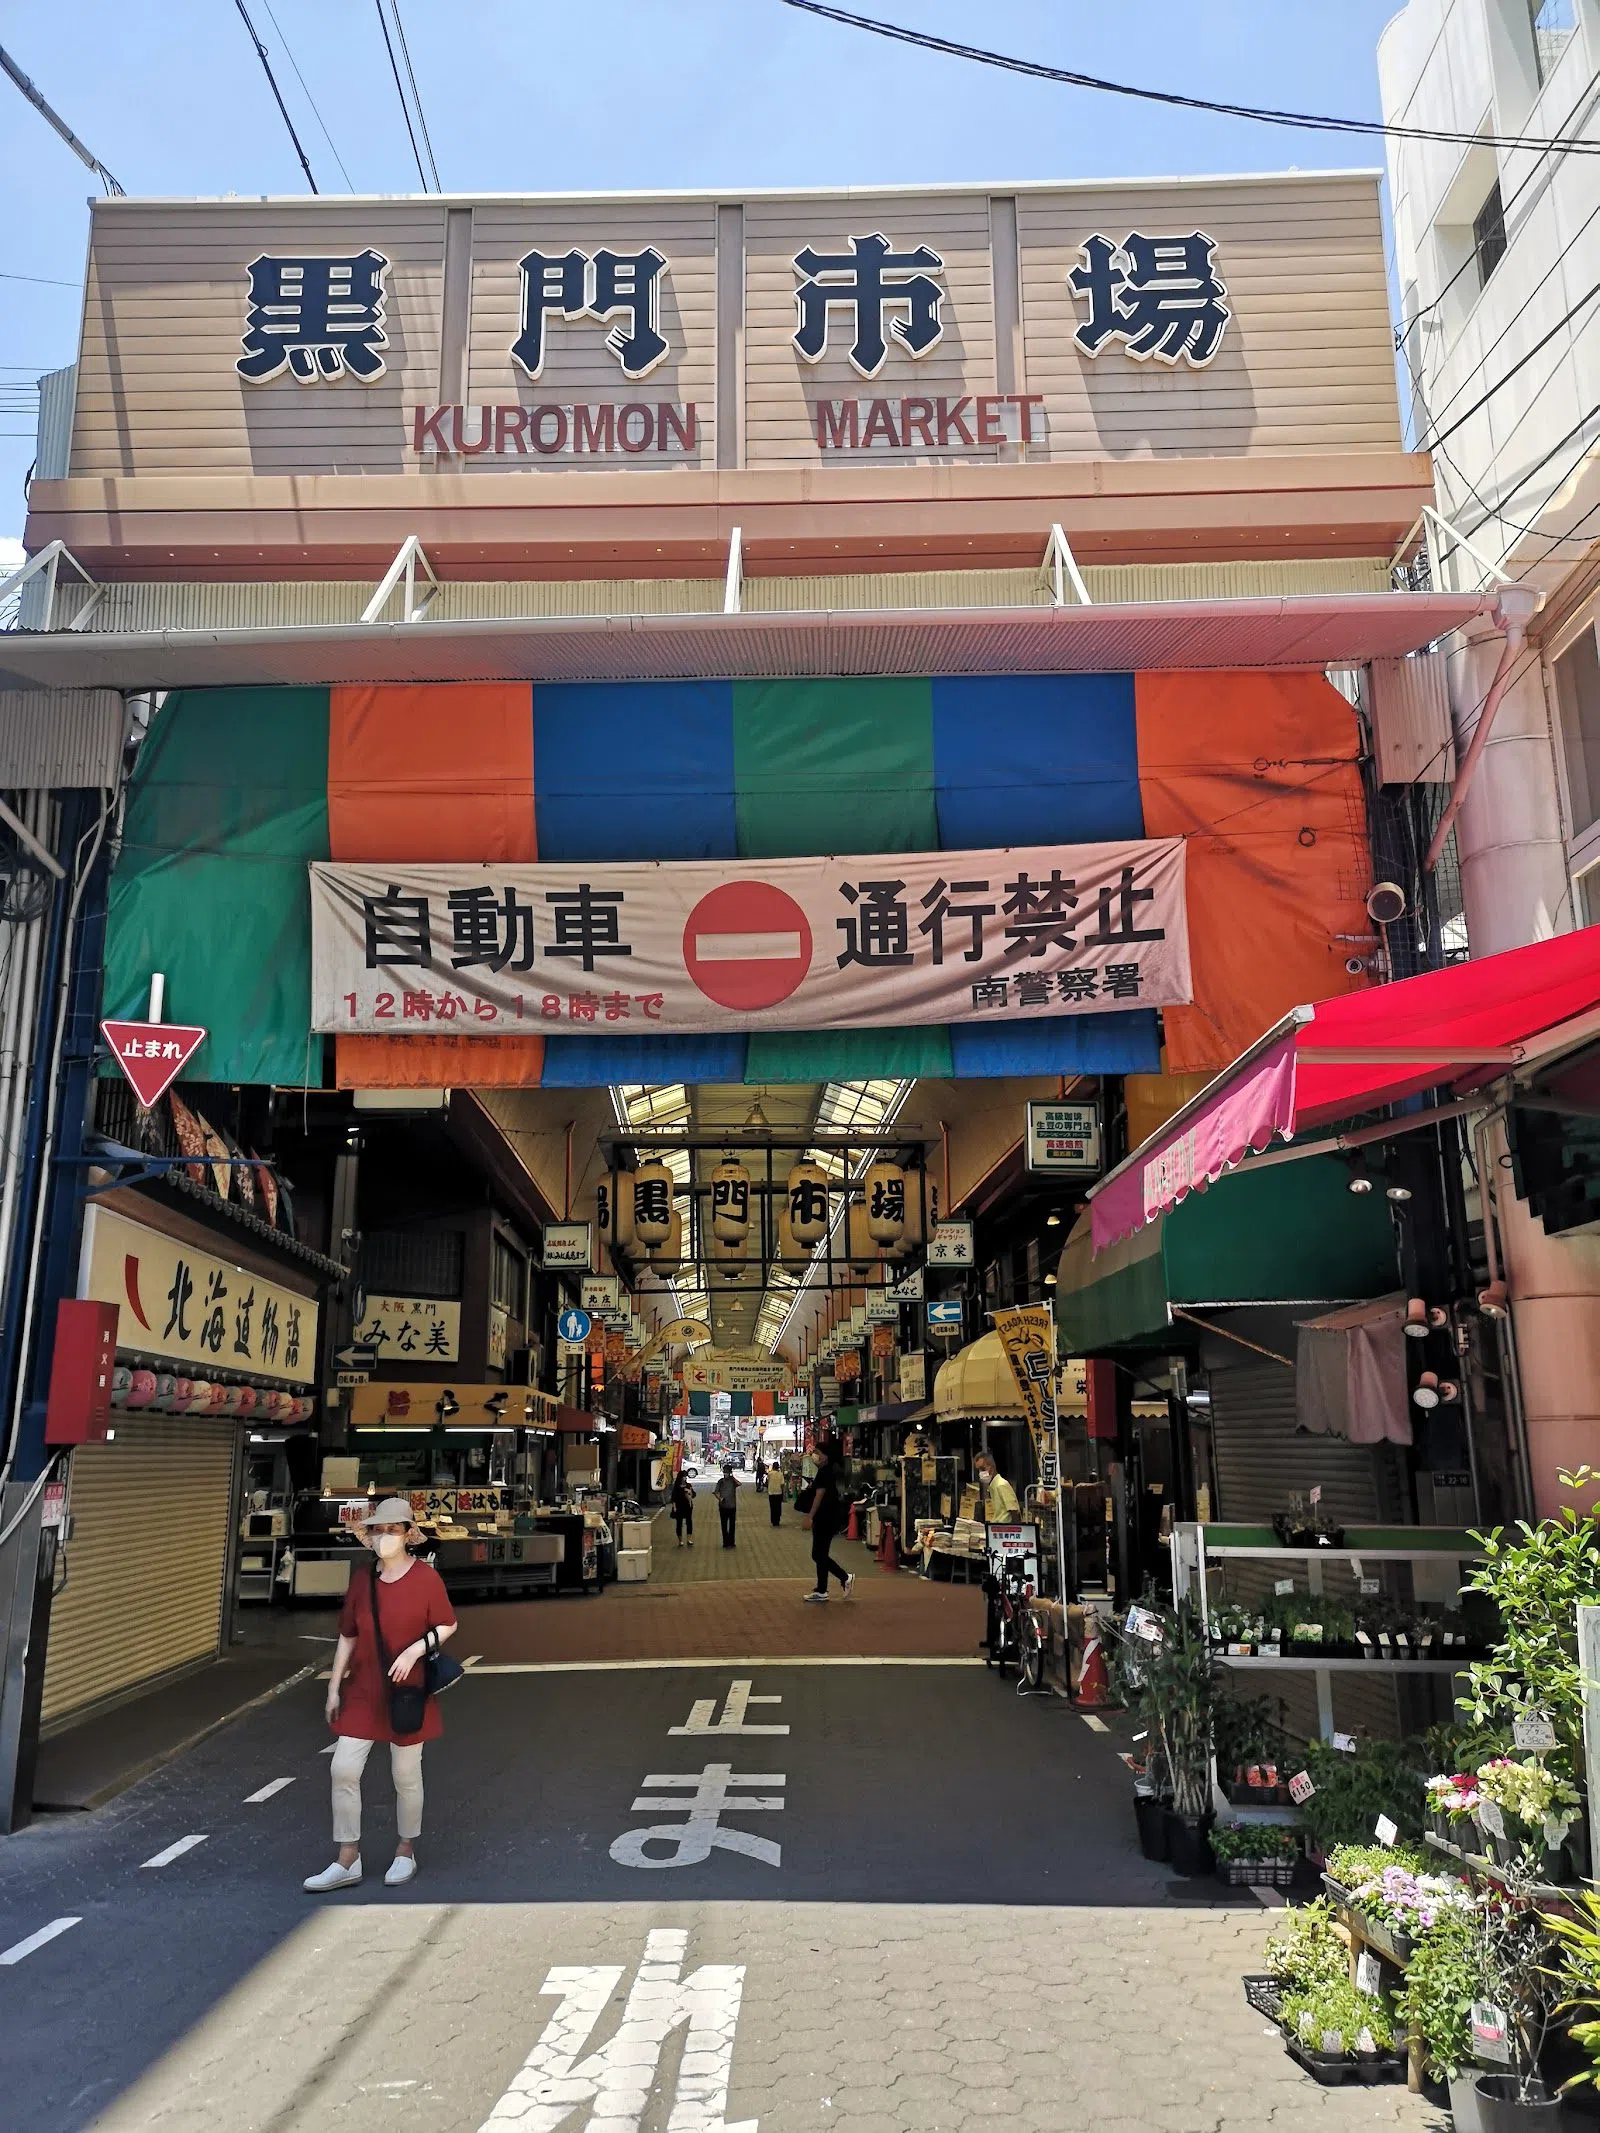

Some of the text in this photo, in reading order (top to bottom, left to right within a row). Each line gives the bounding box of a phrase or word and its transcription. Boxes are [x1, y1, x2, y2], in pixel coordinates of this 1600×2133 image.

[236, 231, 1231, 386] 黒門市場
[413, 395, 1043, 455] KUROMON MARKET
[362, 867, 1166, 972] 自動車 通行禁止
[970, 963, 1145, 1009] 南警察署
[122, 1037, 182, 1060] 止まれ
[935, 1243, 967, 1258] 京栄
[163, 1260, 301, 1368] 北海道物語
[363, 1320, 450, 1356] みな美
[478, 1680, 790, 2133] 止まれ
